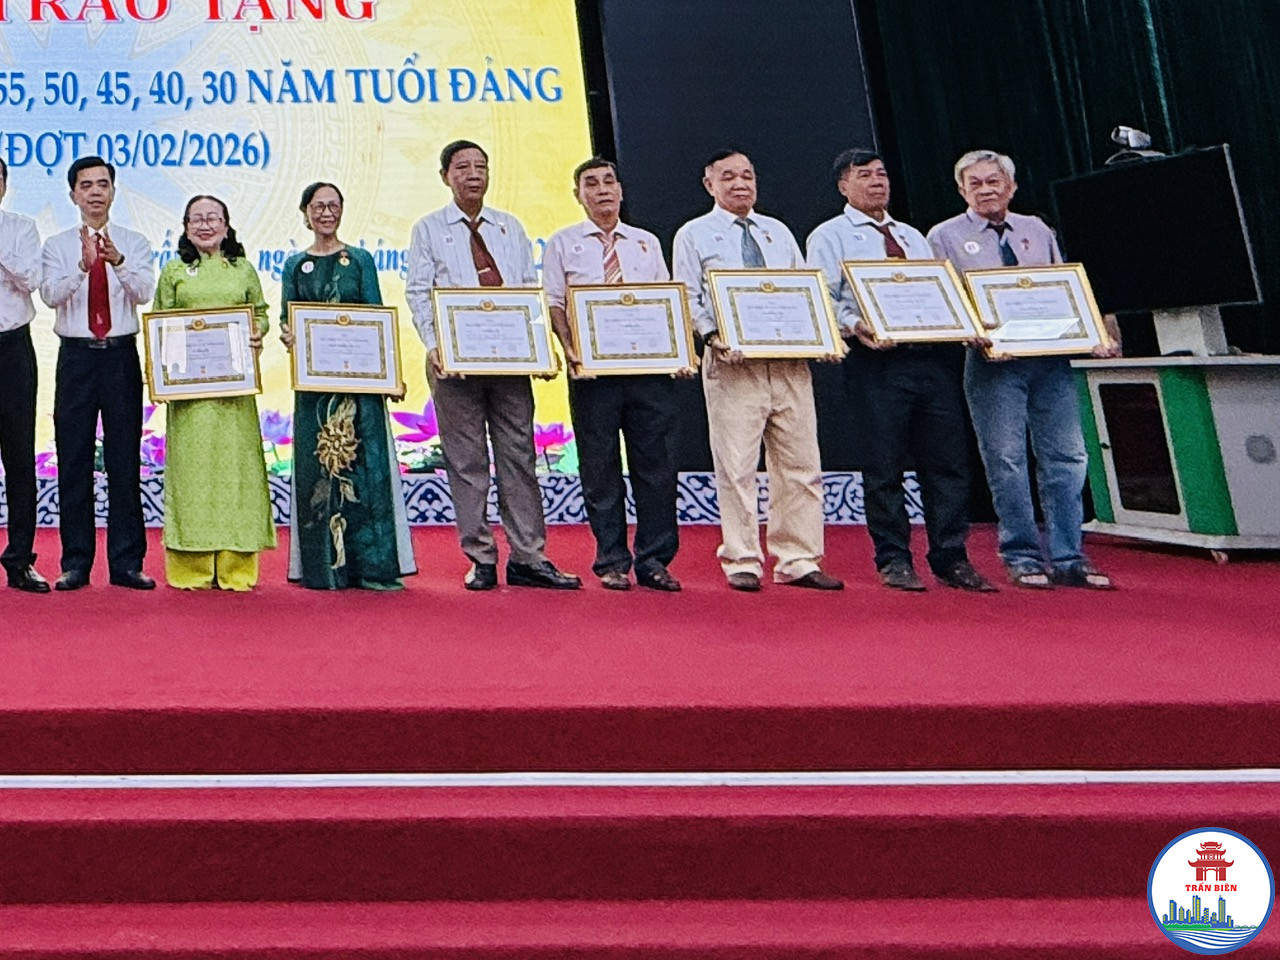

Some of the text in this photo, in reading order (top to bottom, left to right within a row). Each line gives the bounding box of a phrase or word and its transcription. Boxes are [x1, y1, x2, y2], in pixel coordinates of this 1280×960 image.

[44, 71, 90, 112] 50,
[96, 71, 142, 112] 45,
[149, 71, 193, 110] 40,
[204, 71, 237, 104] 30
[246, 59, 336, 104] NĂM
[346, 52, 439, 104] TUỔI
[449, 55, 563, 102] ĐẢNG
[97, 129, 270, 168] 03/02/2026)
